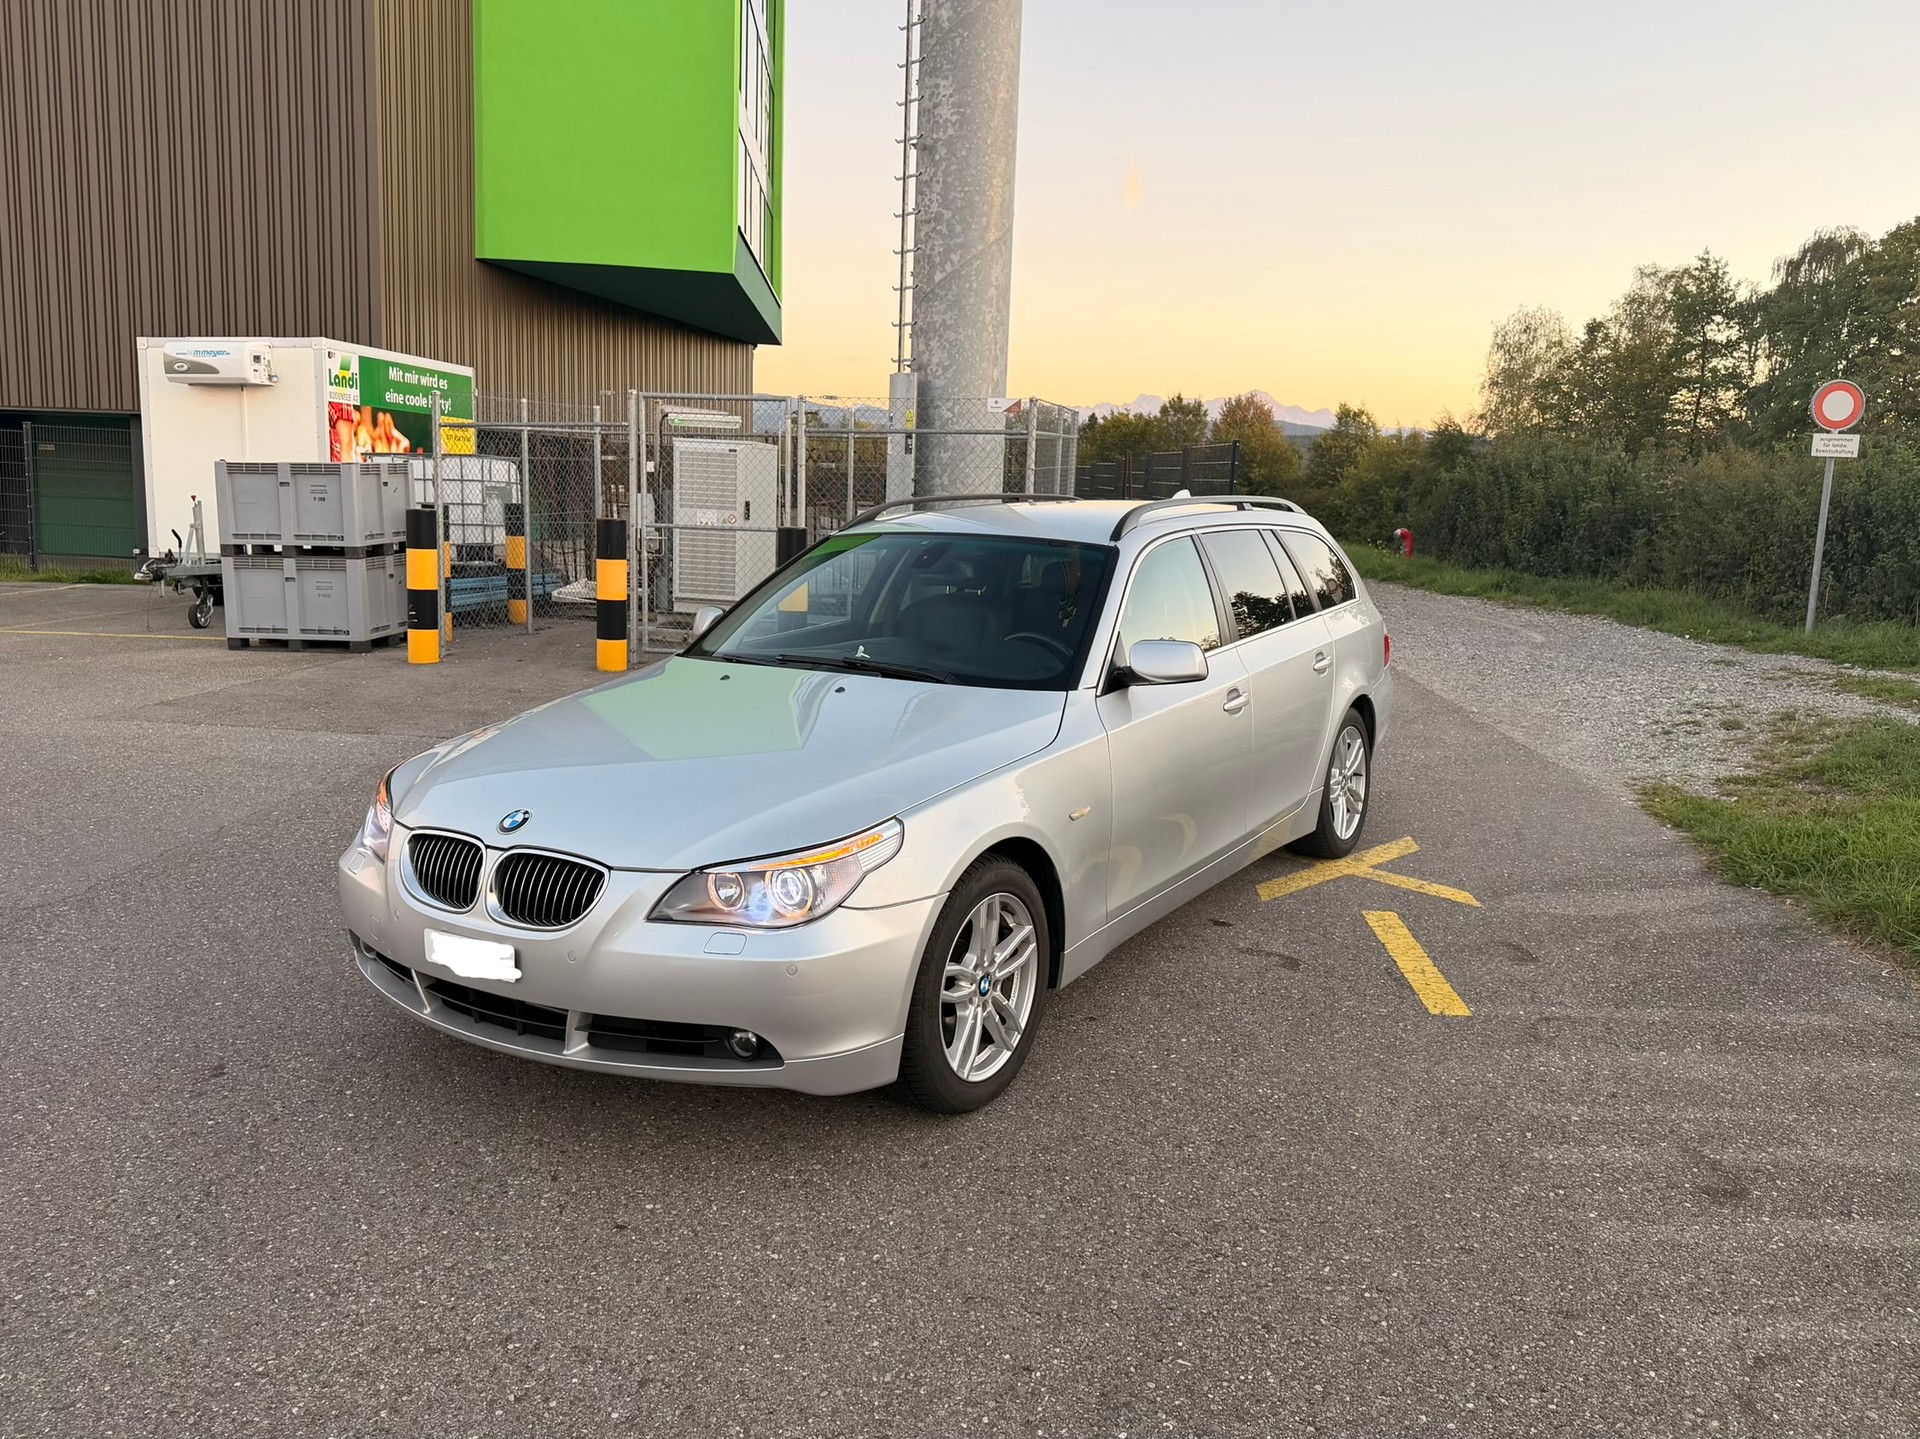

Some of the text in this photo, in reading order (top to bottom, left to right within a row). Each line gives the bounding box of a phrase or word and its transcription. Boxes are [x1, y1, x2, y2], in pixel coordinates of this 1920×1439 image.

[328, 368, 358, 390] Landi
[388, 366, 448, 390] Mit mir wird es
[385, 388, 404, 404] eine
[405, 391, 427, 408] coole
